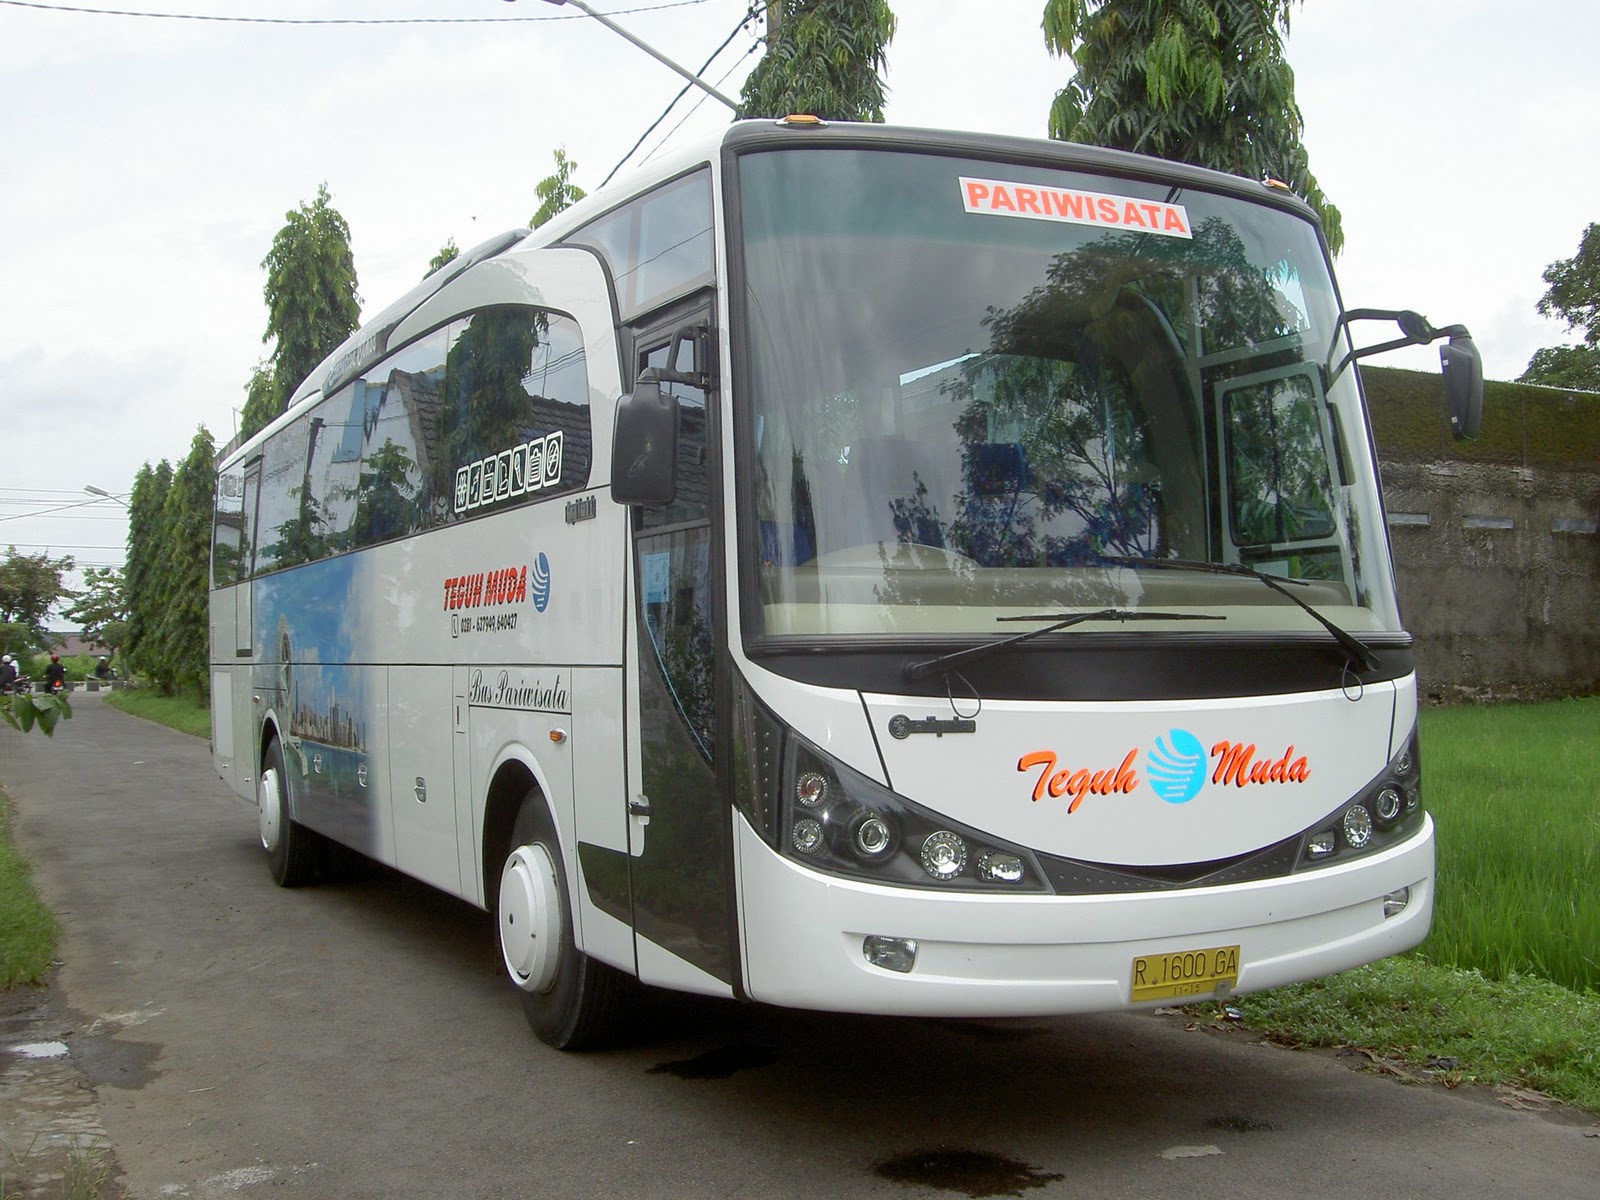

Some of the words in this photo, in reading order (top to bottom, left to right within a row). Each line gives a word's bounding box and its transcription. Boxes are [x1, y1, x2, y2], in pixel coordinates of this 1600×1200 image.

[966, 182, 1187, 233] PARIWISATA
[444, 572, 484, 611] TEGUH
[484, 565, 527, 607] MUDA
[470, 669, 494, 703] Bus
[495, 670, 569, 709] Pariwisata
[1017, 747, 1140, 814] Teguh
[1211, 739, 1312, 788] Muda
[1134, 959, 1146, 986] R
[1162, 952, 1206, 982] 1600
[1215, 949, 1236, 975] GA
